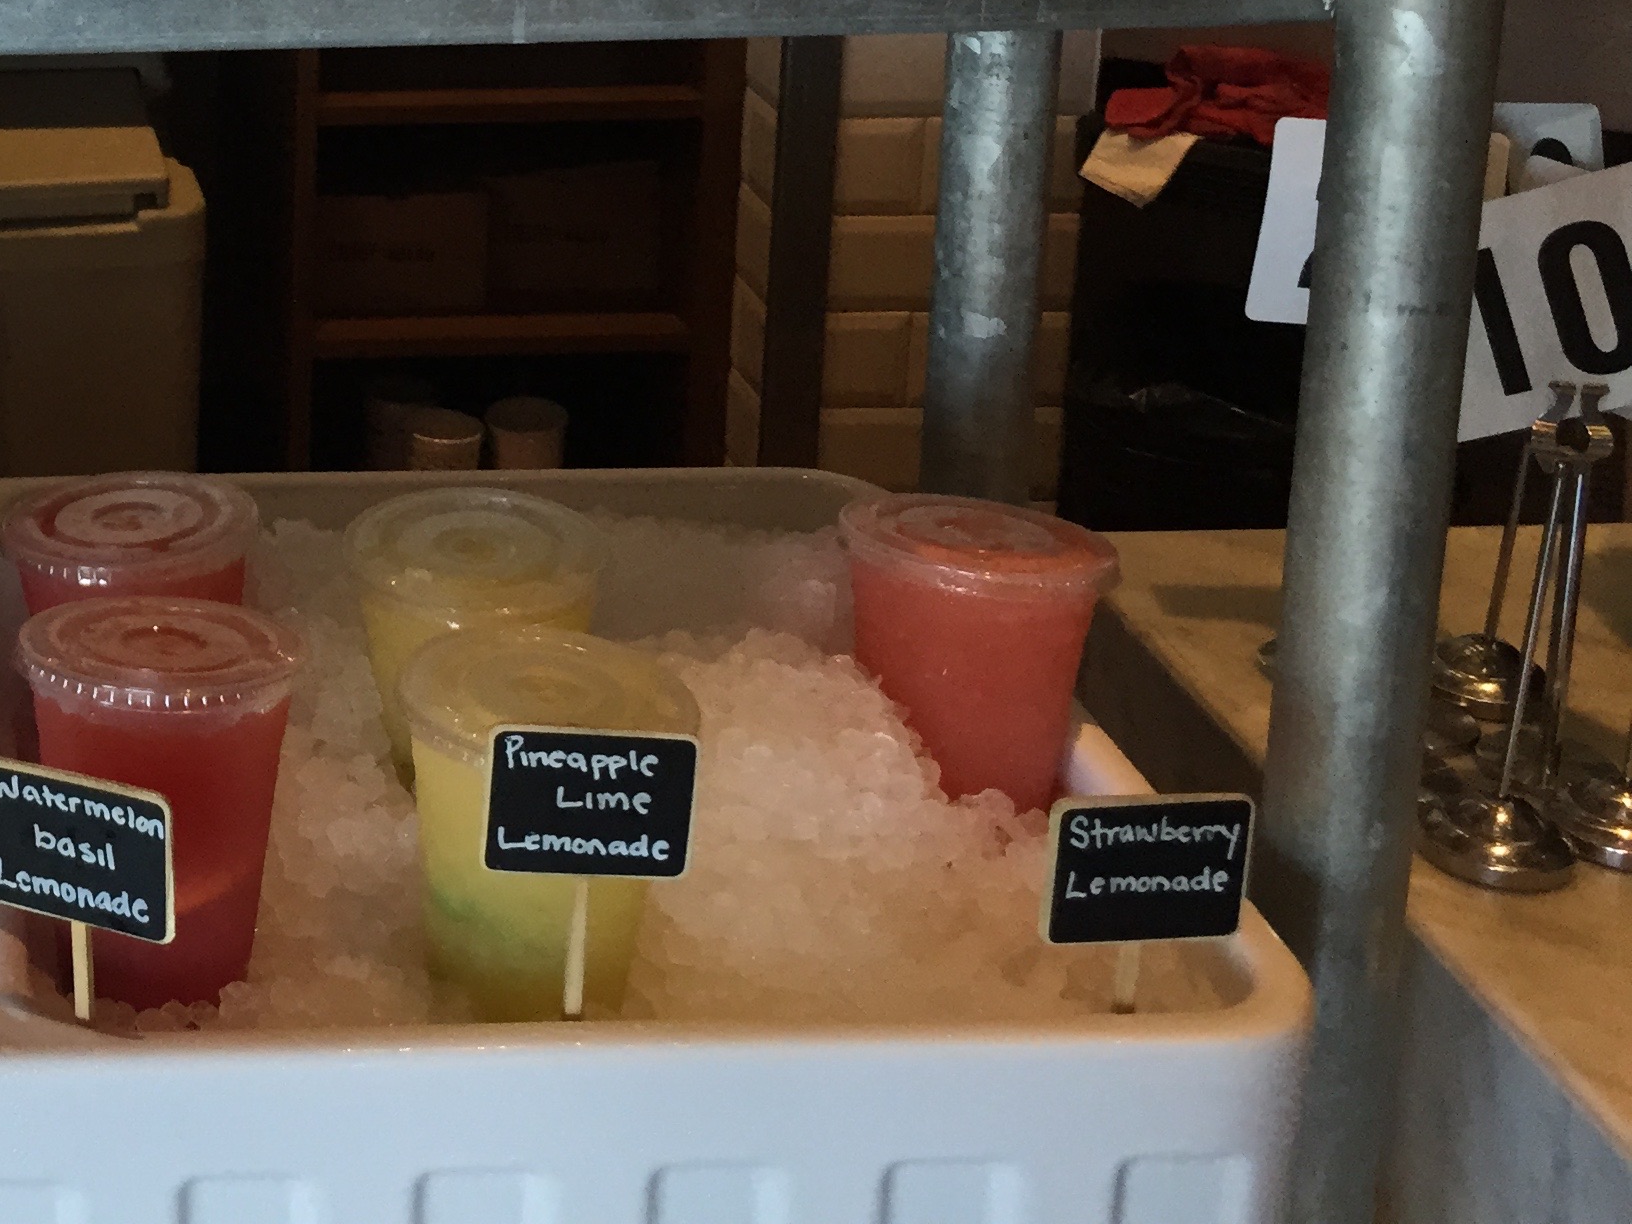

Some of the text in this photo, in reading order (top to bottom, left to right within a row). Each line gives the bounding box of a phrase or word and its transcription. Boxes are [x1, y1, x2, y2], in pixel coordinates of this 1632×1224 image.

[1473, 219, 1632, 397] 10
[504, 734, 659, 781] Pineapple
[555, 785, 653, 815] Lime
[33, 823, 116, 871] basil
[497, 825, 670, 861] Lemonade
[1069, 814, 1241, 860] Strawberry
[1065, 865, 1230, 899] Lemonade
